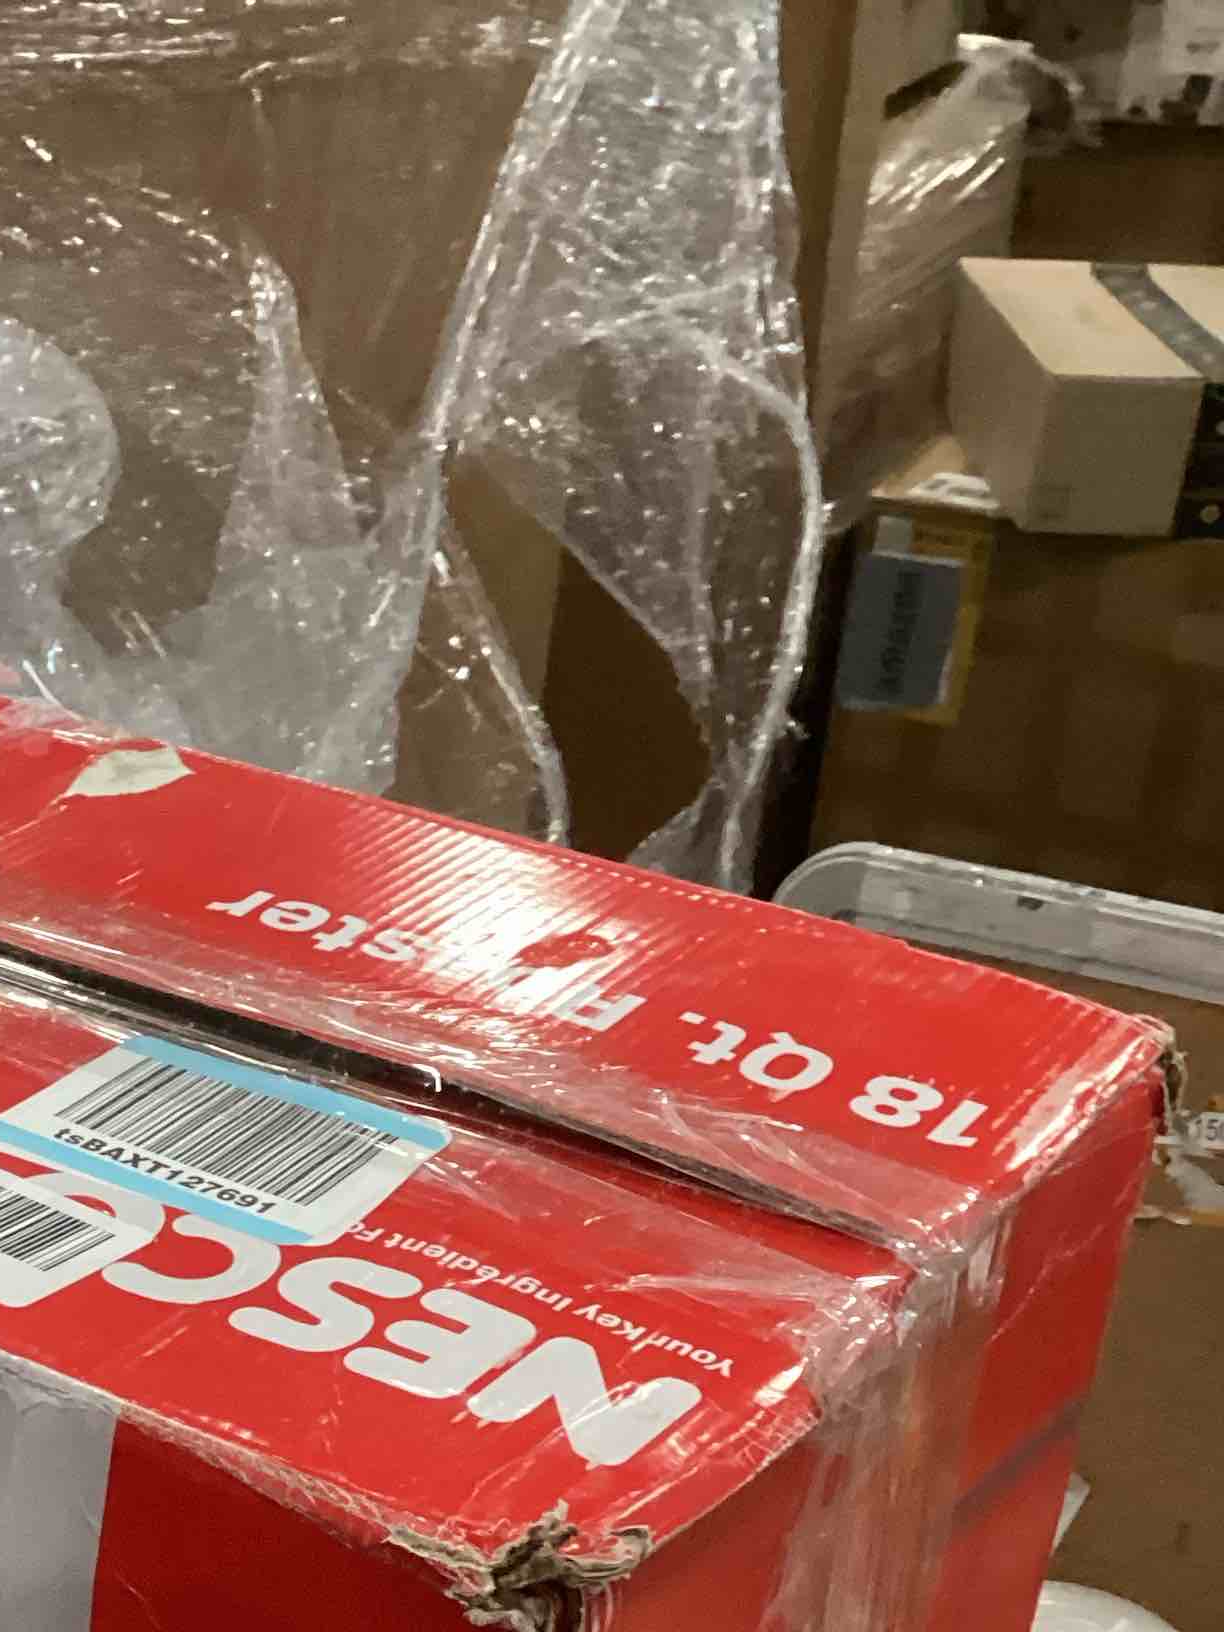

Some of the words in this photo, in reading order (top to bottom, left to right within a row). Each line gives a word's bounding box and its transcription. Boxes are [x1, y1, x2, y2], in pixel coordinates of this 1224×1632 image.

[677, 1009, 834, 1092] Qt.
[849, 1072, 990, 1148] 18
[53, 1127, 276, 1216] tsBAXT127691
[383, 1231, 574, 1312] Ingredient
[574, 1303, 645, 1351] Key
[645, 1330, 735, 1377] Your
